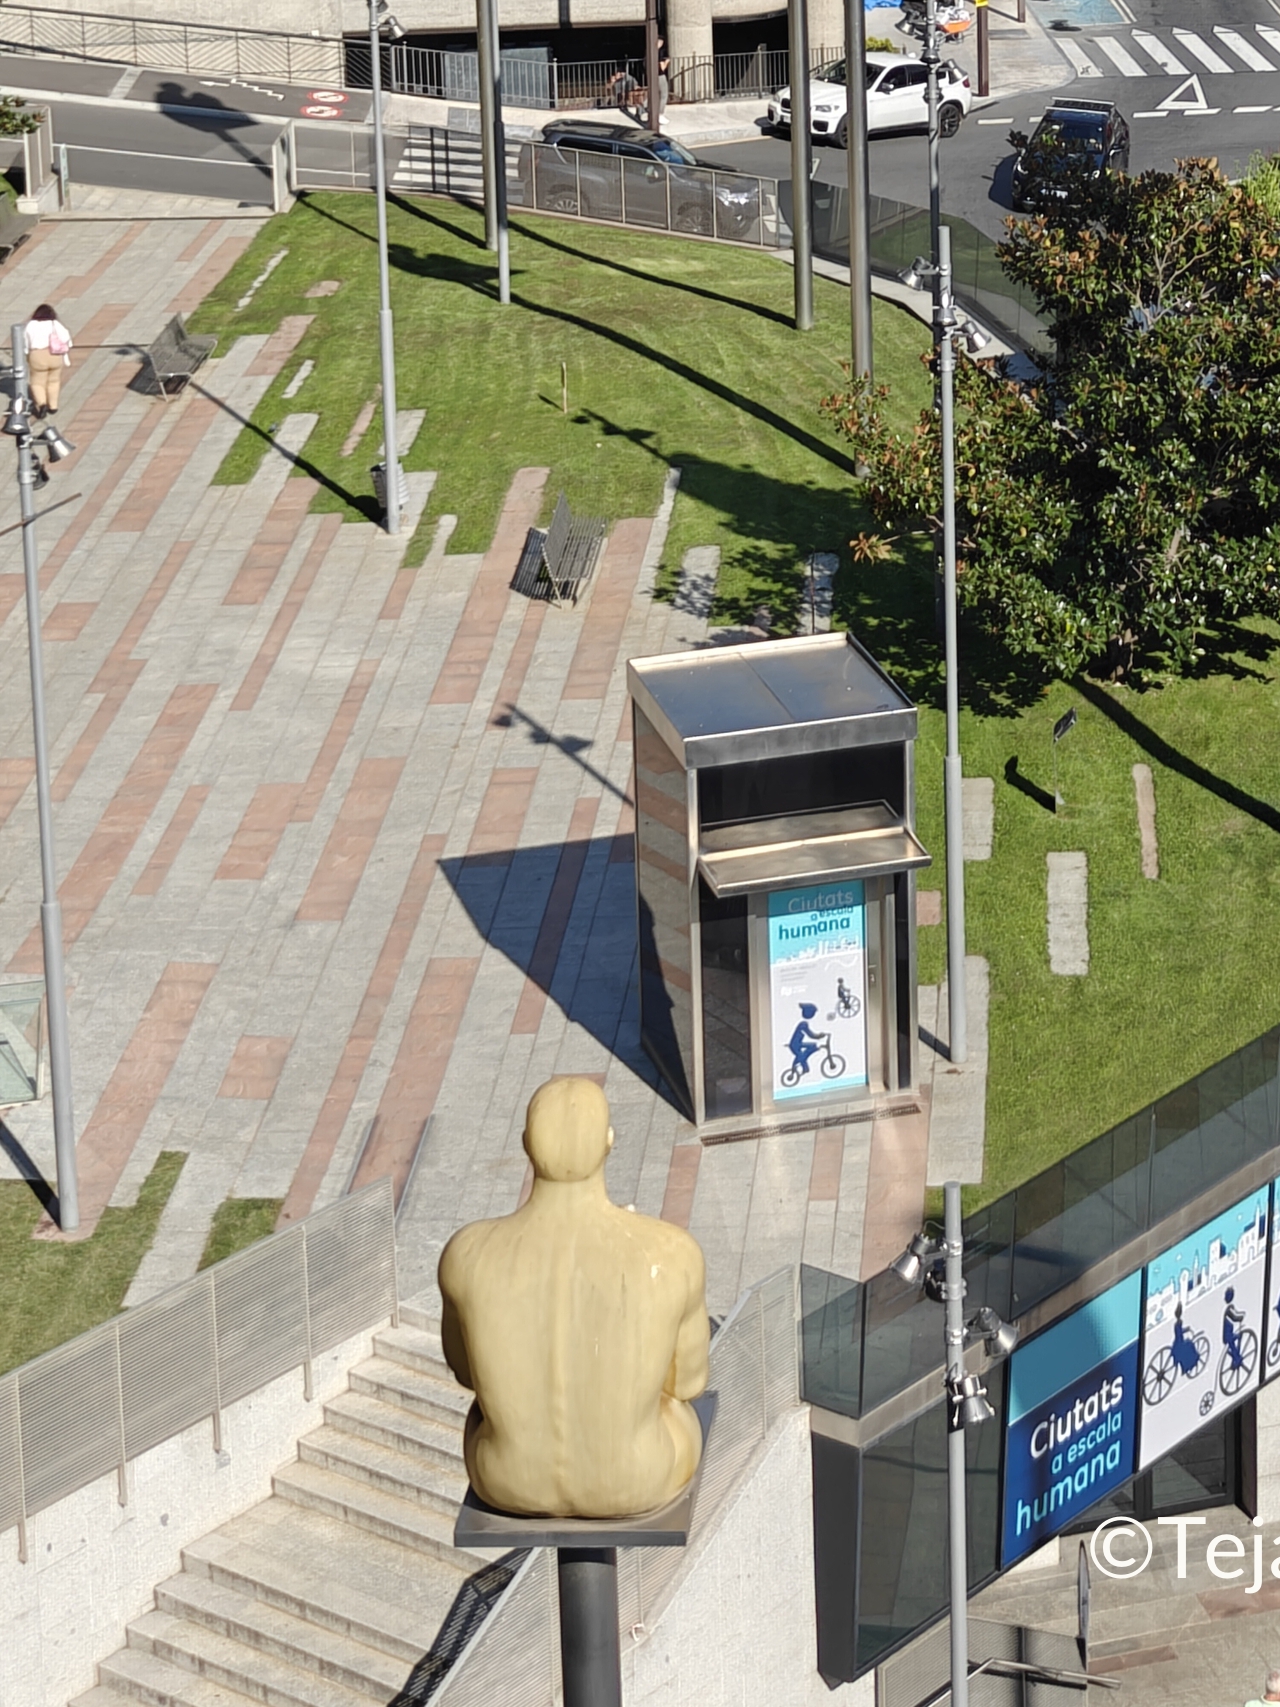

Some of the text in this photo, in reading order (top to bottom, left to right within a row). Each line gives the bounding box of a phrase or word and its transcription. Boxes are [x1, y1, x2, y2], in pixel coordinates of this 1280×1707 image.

[787, 889, 854, 913] Ciutats
[810, 905, 854, 922] a escala
[778, 917, 851, 940] humana
[1030, 1375, 1124, 1460] Ciutats
[1051, 1411, 1122, 1475] a escala
[1015, 1440, 1121, 1537] humana
